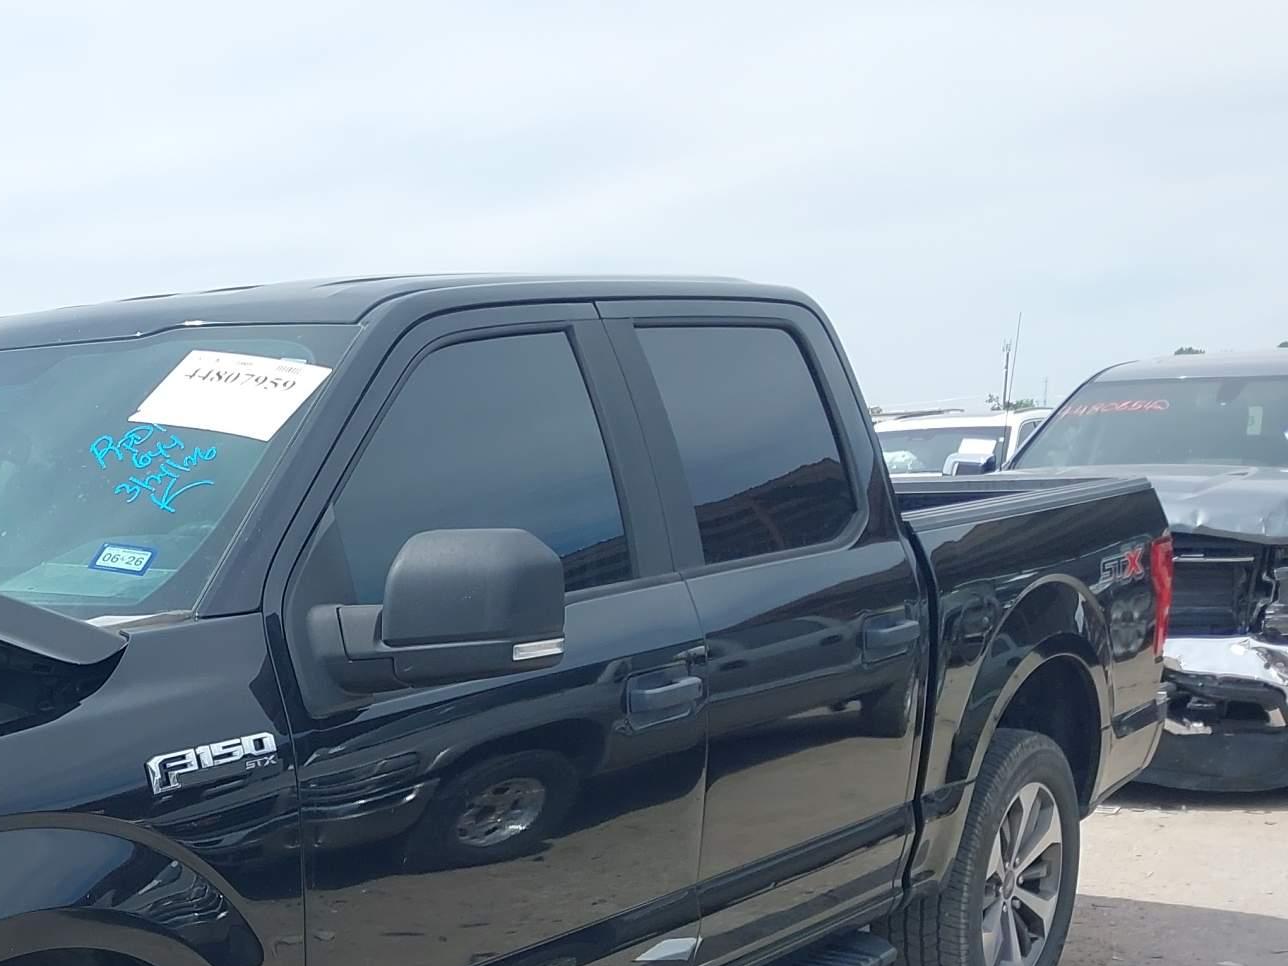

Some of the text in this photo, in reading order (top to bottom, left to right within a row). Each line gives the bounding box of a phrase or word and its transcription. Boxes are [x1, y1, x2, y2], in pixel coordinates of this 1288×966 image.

[184, 367, 298, 392] 44807959
[102, 552, 121, 564] 06
[125, 555, 145, 567] 26
[1100, 545, 1146, 582] STX
[245, 754, 278, 770] STX
